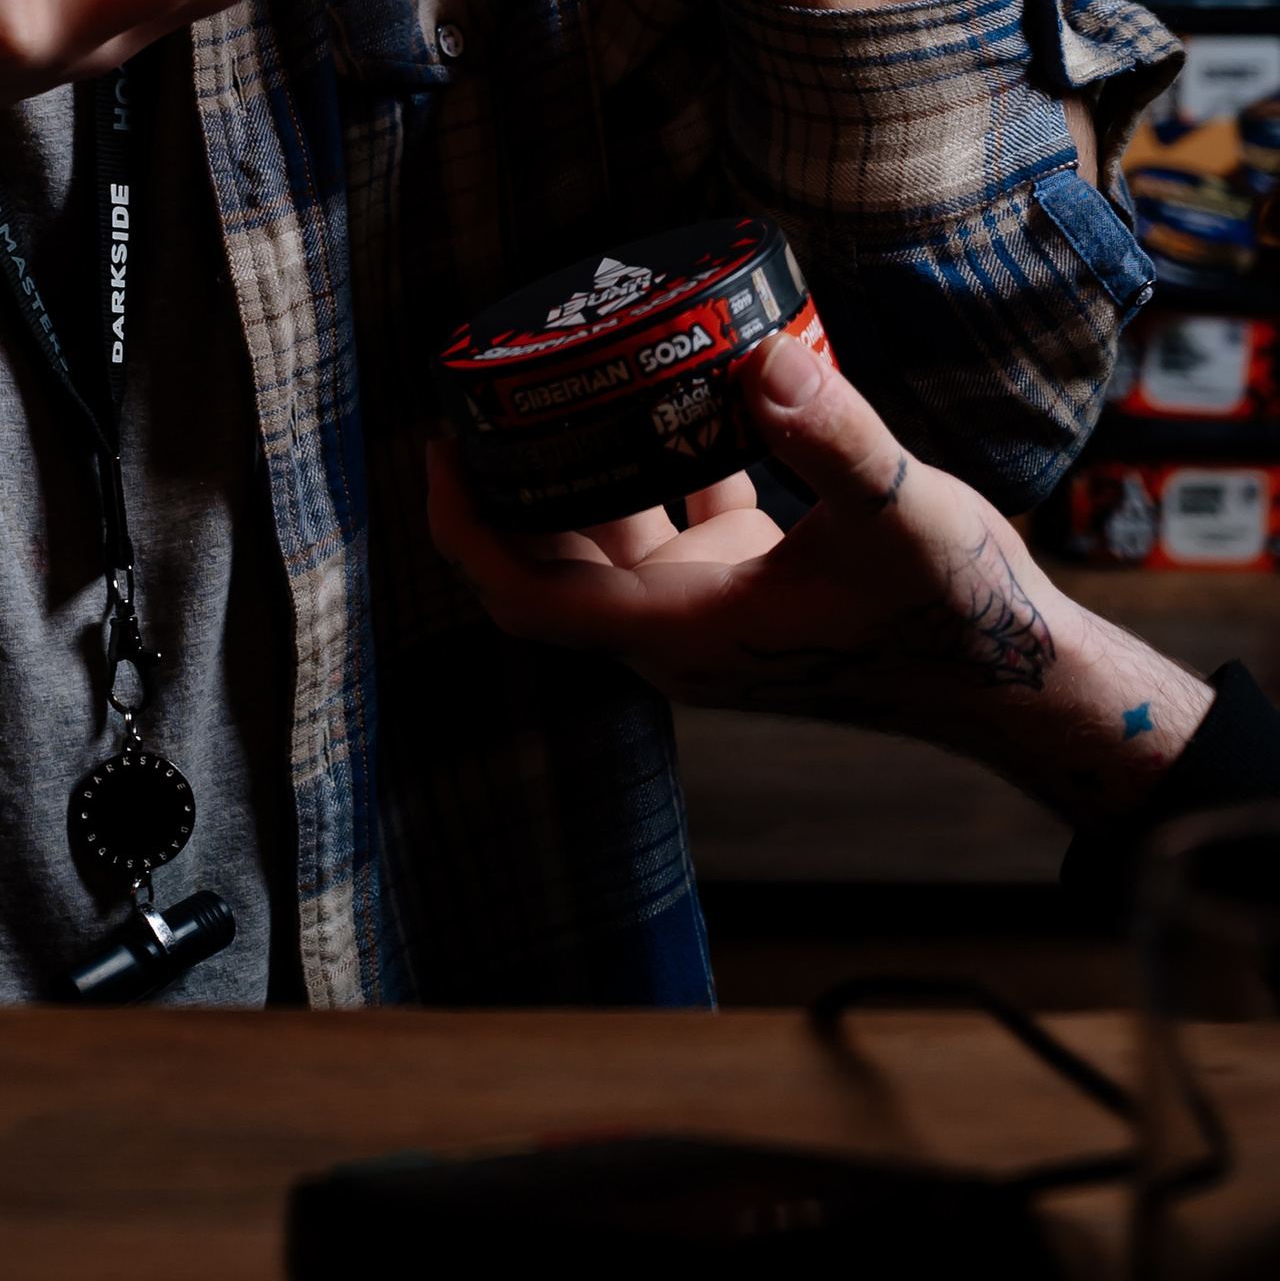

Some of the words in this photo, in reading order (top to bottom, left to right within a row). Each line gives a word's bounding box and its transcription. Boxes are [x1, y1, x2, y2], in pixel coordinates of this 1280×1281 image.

[110, 183, 130, 364] DARKSIDE
[513, 360, 631, 413] SIBERIAN
[639, 325, 714, 373] SODA
[83, 755, 187, 800] DARKSIDE
